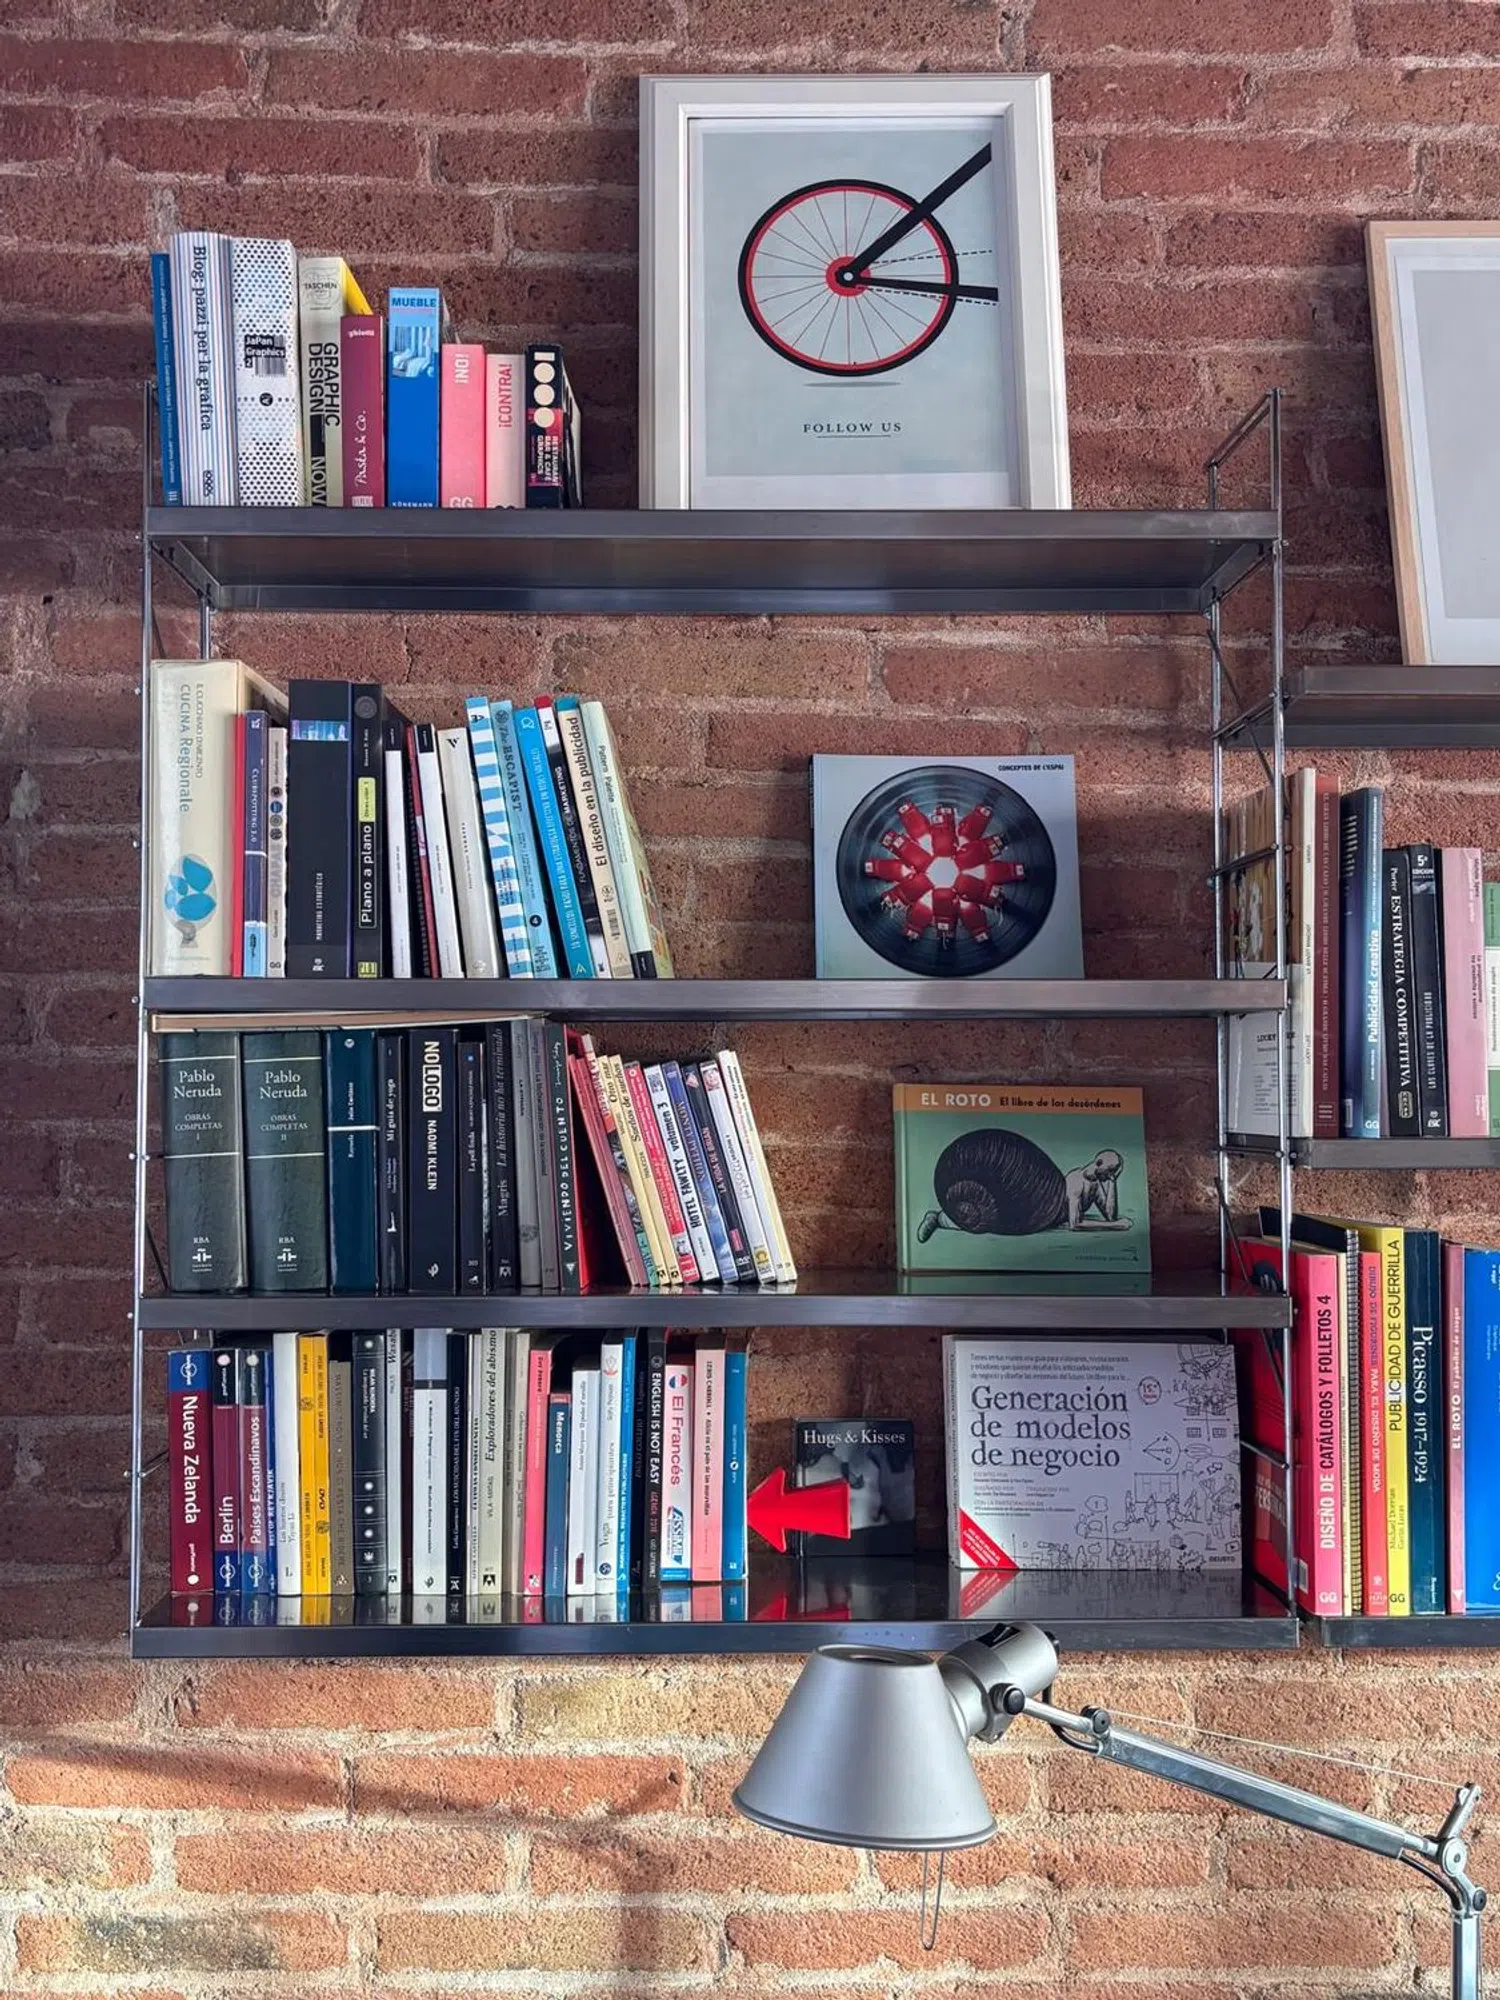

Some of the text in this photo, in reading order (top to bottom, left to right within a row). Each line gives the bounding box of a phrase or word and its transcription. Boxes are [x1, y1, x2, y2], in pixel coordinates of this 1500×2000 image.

[304, 282, 338, 290] TASCHEN
[391, 297, 437, 308] MUEBLE
[191, 246, 213, 431] Blog: pazzi per la grafica
[245, 346, 285, 357] Graphics
[323, 342, 341, 427] GRAPHIC
[454, 354, 470, 384] ¡NO!
[498, 364, 513, 428] ¡CONTRA!
[308, 343, 328, 507] DESIGN NOW
[802, 421, 902, 434] FOLLOW US
[354, 410, 368, 489] Pasta Co.
[177, 683, 193, 813] CUCINA Regionale
[505, 745, 522, 813] ESCAPIST
[554, 766, 573, 815] MARKETING
[569, 716, 607, 867] El diseño en la publicidad
[361, 825, 375, 923] Plano a plano
[1369, 929, 1380, 978] creativa
[1390, 867, 1412, 1087] Porter ESTRATEGIA COMPETITIVA
[1367, 979, 1380, 1043] Publicidad
[1423, 991, 1434, 1029] PUBLICIDAD
[173, 1084, 222, 1099] Neruda
[178, 1069, 216, 1084] Pablo
[259, 1085, 308, 1100] Neruda
[264, 1069, 301, 1084] Pablo
[494, 1081, 504, 1094] ha
[184, 1112, 212, 1122] OBRAS
[385, 1079, 396, 1141] Mi de yoga
[496, 1097, 505, 1110] no
[614, 1063, 641, 1142] Sueños de sueños
[921, 1092, 1122, 1109] EL ROTO El libro de los desórdenes
[174, 1121, 223, 1131] COMPLETAS
[260, 1122, 309, 1131] COMPLETAS
[270, 1113, 298, 1122] OBRAS
[494, 1111, 507, 1151] historia
[676, 1100, 694, 1141] MONTY
[1365, 1120, 1379, 1129] GG
[426, 1119, 438, 1191] NAOMI KLEIN
[702, 1127, 717, 1151] BRIAN
[496, 1152, 507, 1168] La
[663, 1111, 702, 1228] HOTEL FAWLTY volumen
[709, 1152, 719, 1162] DE
[712, 1163, 725, 1182] VIDA
[555, 1097, 574, 1251] VIVIENDO DEL CUENTO
[497, 1179, 510, 1217] Magris
[192, 1236, 211, 1244] RBA
[278, 1236, 296, 1244] RBA
[1367, 1266, 1377, 1299] DIBUJO
[1386, 1239, 1403, 1432] PUBLICIDAD DE GUERRILLA
[1370, 1368, 1379, 1392] PARA
[1411, 1325, 1434, 1404] Picasso
[485, 1330, 498, 1462] Exploradores del abismo
[651, 1372, 661, 1417] ENGLISH
[971, 1385, 1129, 1412] Generación
[1371, 1395, 1380, 1407] EL
[555, 1411, 565, 1454] Menorca
[651, 1420, 660, 1429] IS
[803, 1429, 906, 1447] Hugs & Kisses
[970, 1411, 1131, 1440] de modelos
[1316, 1295, 1336, 1549] DISEÑO DE CATÁLOGOS Y FOLLETOS 4
[1371, 1409, 1381, 1446] DISEÑO
[1451, 1394, 1462, 1450] EL ROTO
[650, 1431, 660, 1454] NOT
[670, 1395, 684, 1486] El Francés
[1371, 1448, 1380, 1461] DE
[183, 1396, 202, 1524] Nueva Zelanda
[650, 1457, 660, 1485] EASY
[970, 1440, 1120, 1476] de negocio
[249, 1416, 261, 1544] Países Escandinavos
[1372, 1464, 1381, 1493] MODA
[218, 1495, 234, 1544] Berlín
[599, 1522, 610, 1547] Yoga
[1389, 1593, 1405, 1603] GG
